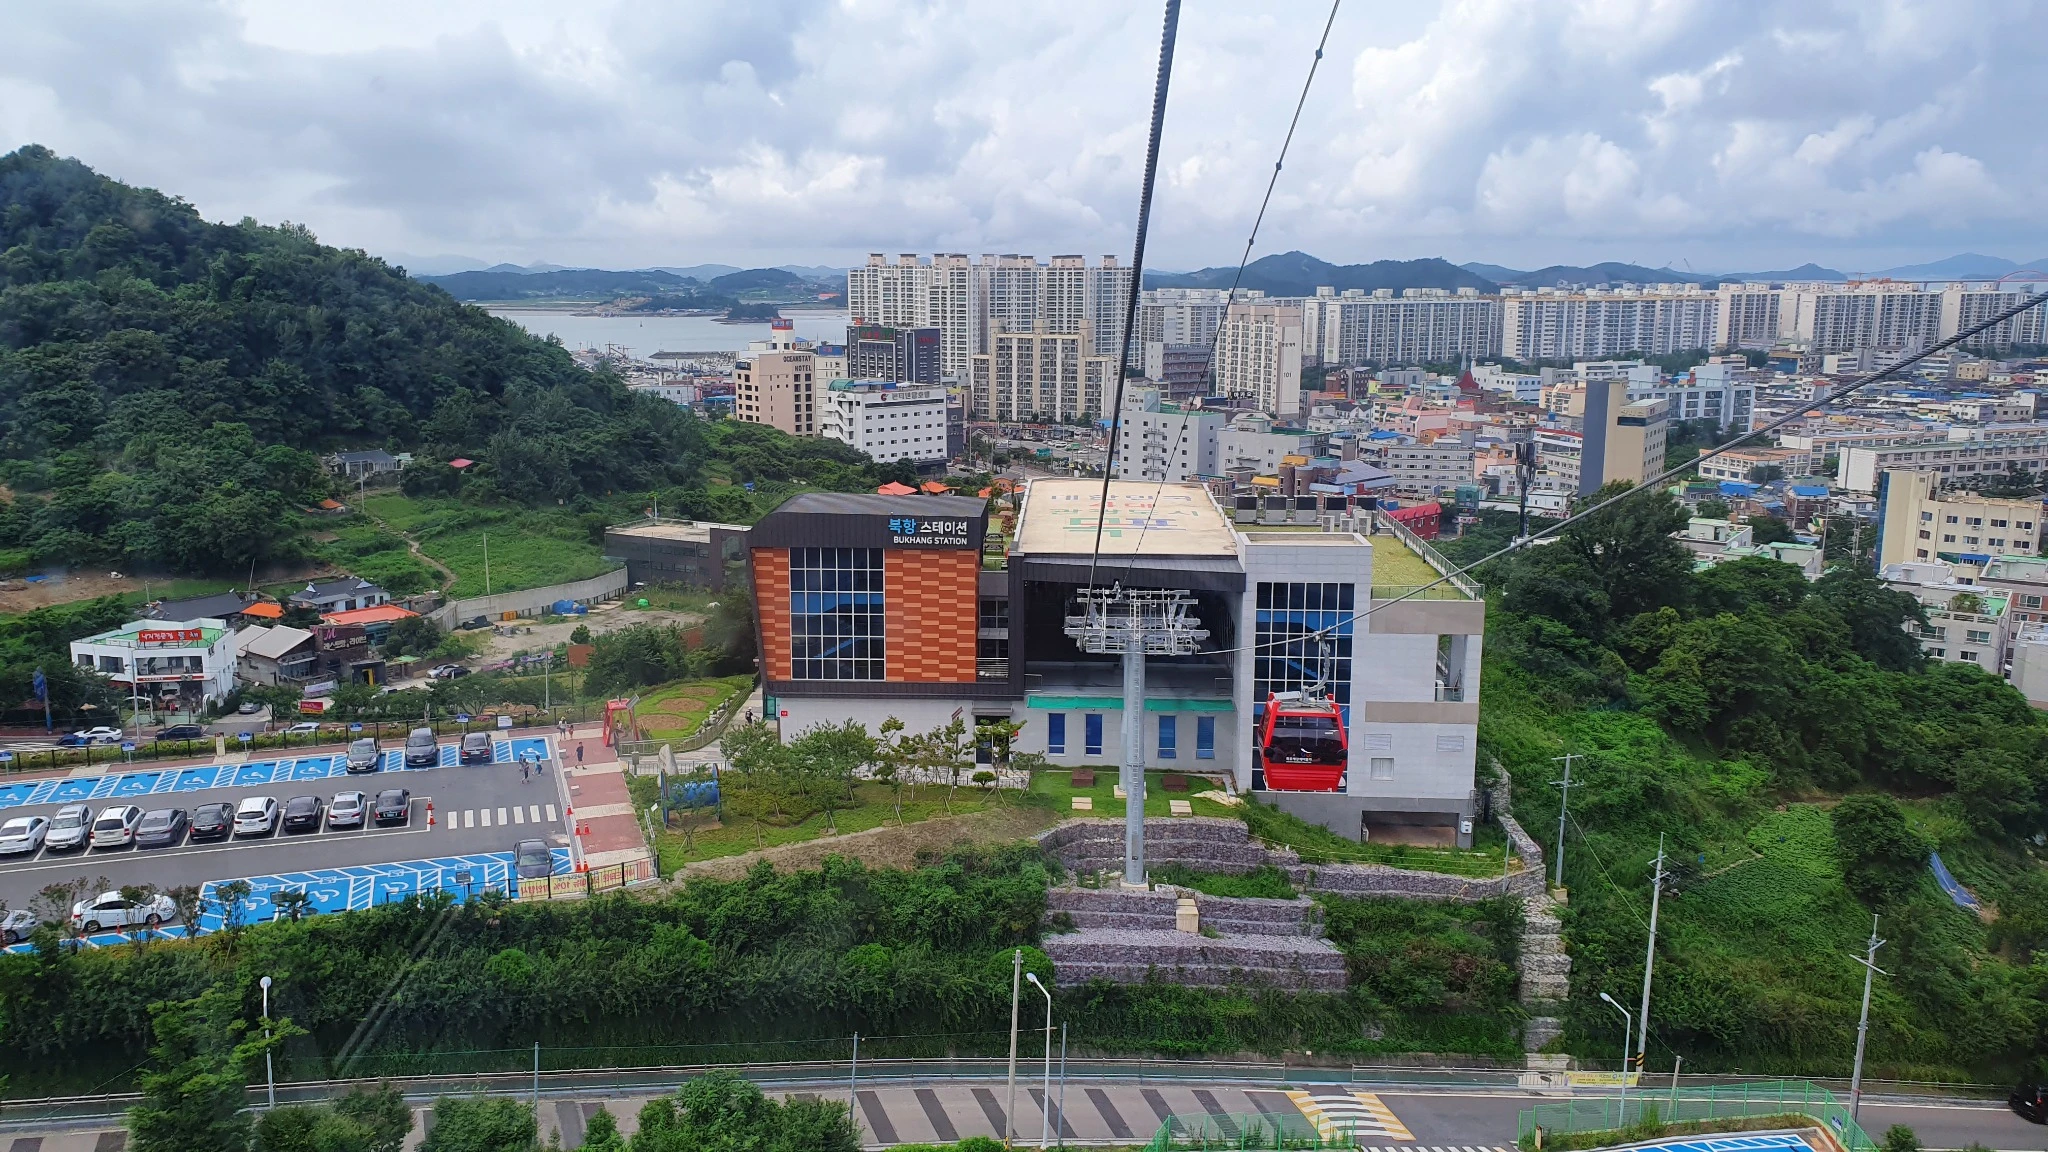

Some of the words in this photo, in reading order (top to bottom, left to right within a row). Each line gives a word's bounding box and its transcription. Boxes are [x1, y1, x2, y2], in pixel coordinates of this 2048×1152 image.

[794, 364, 812, 372] HOTEL
[888, 518, 917, 535] 북항
[919, 520, 968, 535] 스테이션
[893, 535, 933, 544] BUKHANG
[934, 537, 968, 545] STATION
